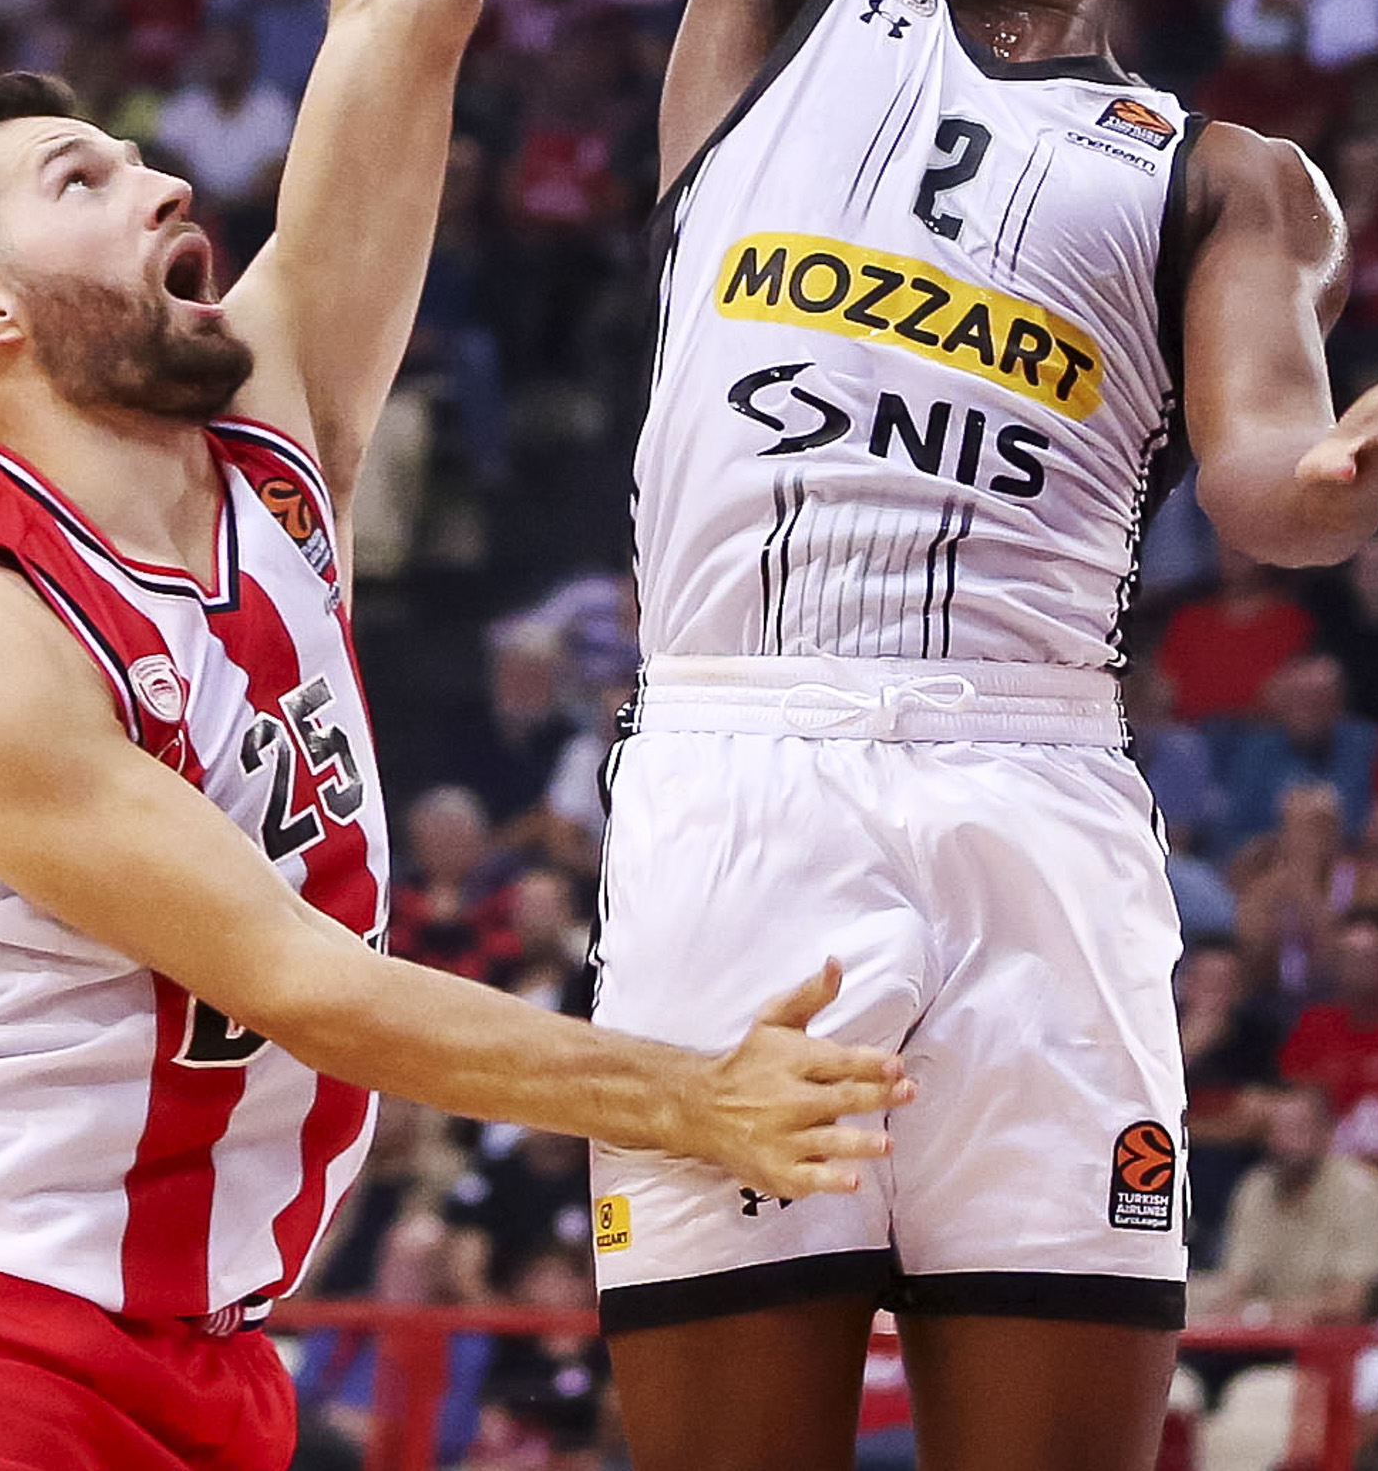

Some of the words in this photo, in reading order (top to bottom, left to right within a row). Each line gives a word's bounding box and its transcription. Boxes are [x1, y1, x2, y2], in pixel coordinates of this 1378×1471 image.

[911, 115, 992, 241] 2
[722, 246, 1095, 402] MOZZART
[867, 391, 1051, 499] NIS
[239, 675, 368, 862] 25
[1116, 1204, 1168, 1217] AIRLINES
[1117, 1192, 1169, 1206] TURKISH
